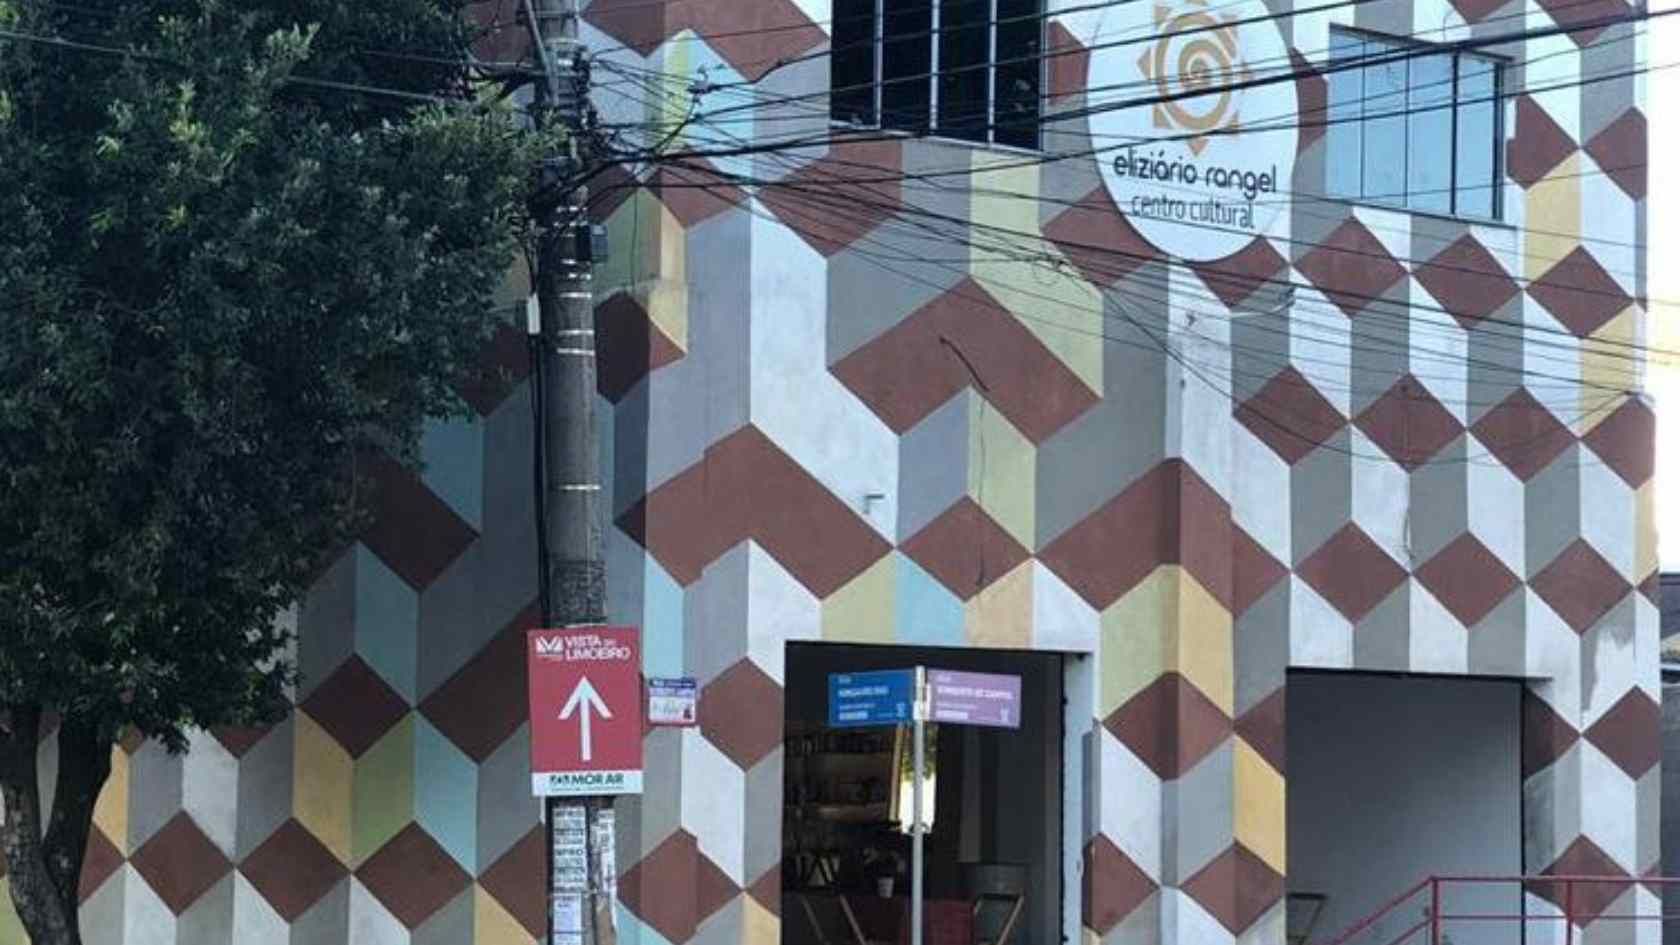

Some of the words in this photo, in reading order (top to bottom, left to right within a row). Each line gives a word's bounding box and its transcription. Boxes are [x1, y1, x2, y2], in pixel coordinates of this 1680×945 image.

[1113, 146, 1198, 184] eliziário
[1205, 164, 1277, 200] rangel
[1132, 195, 1186, 220] centro
[1189, 199, 1255, 229] cultural
[564, 634, 601, 648] VISTA
[564, 646, 631, 661] LIMOEIRO
